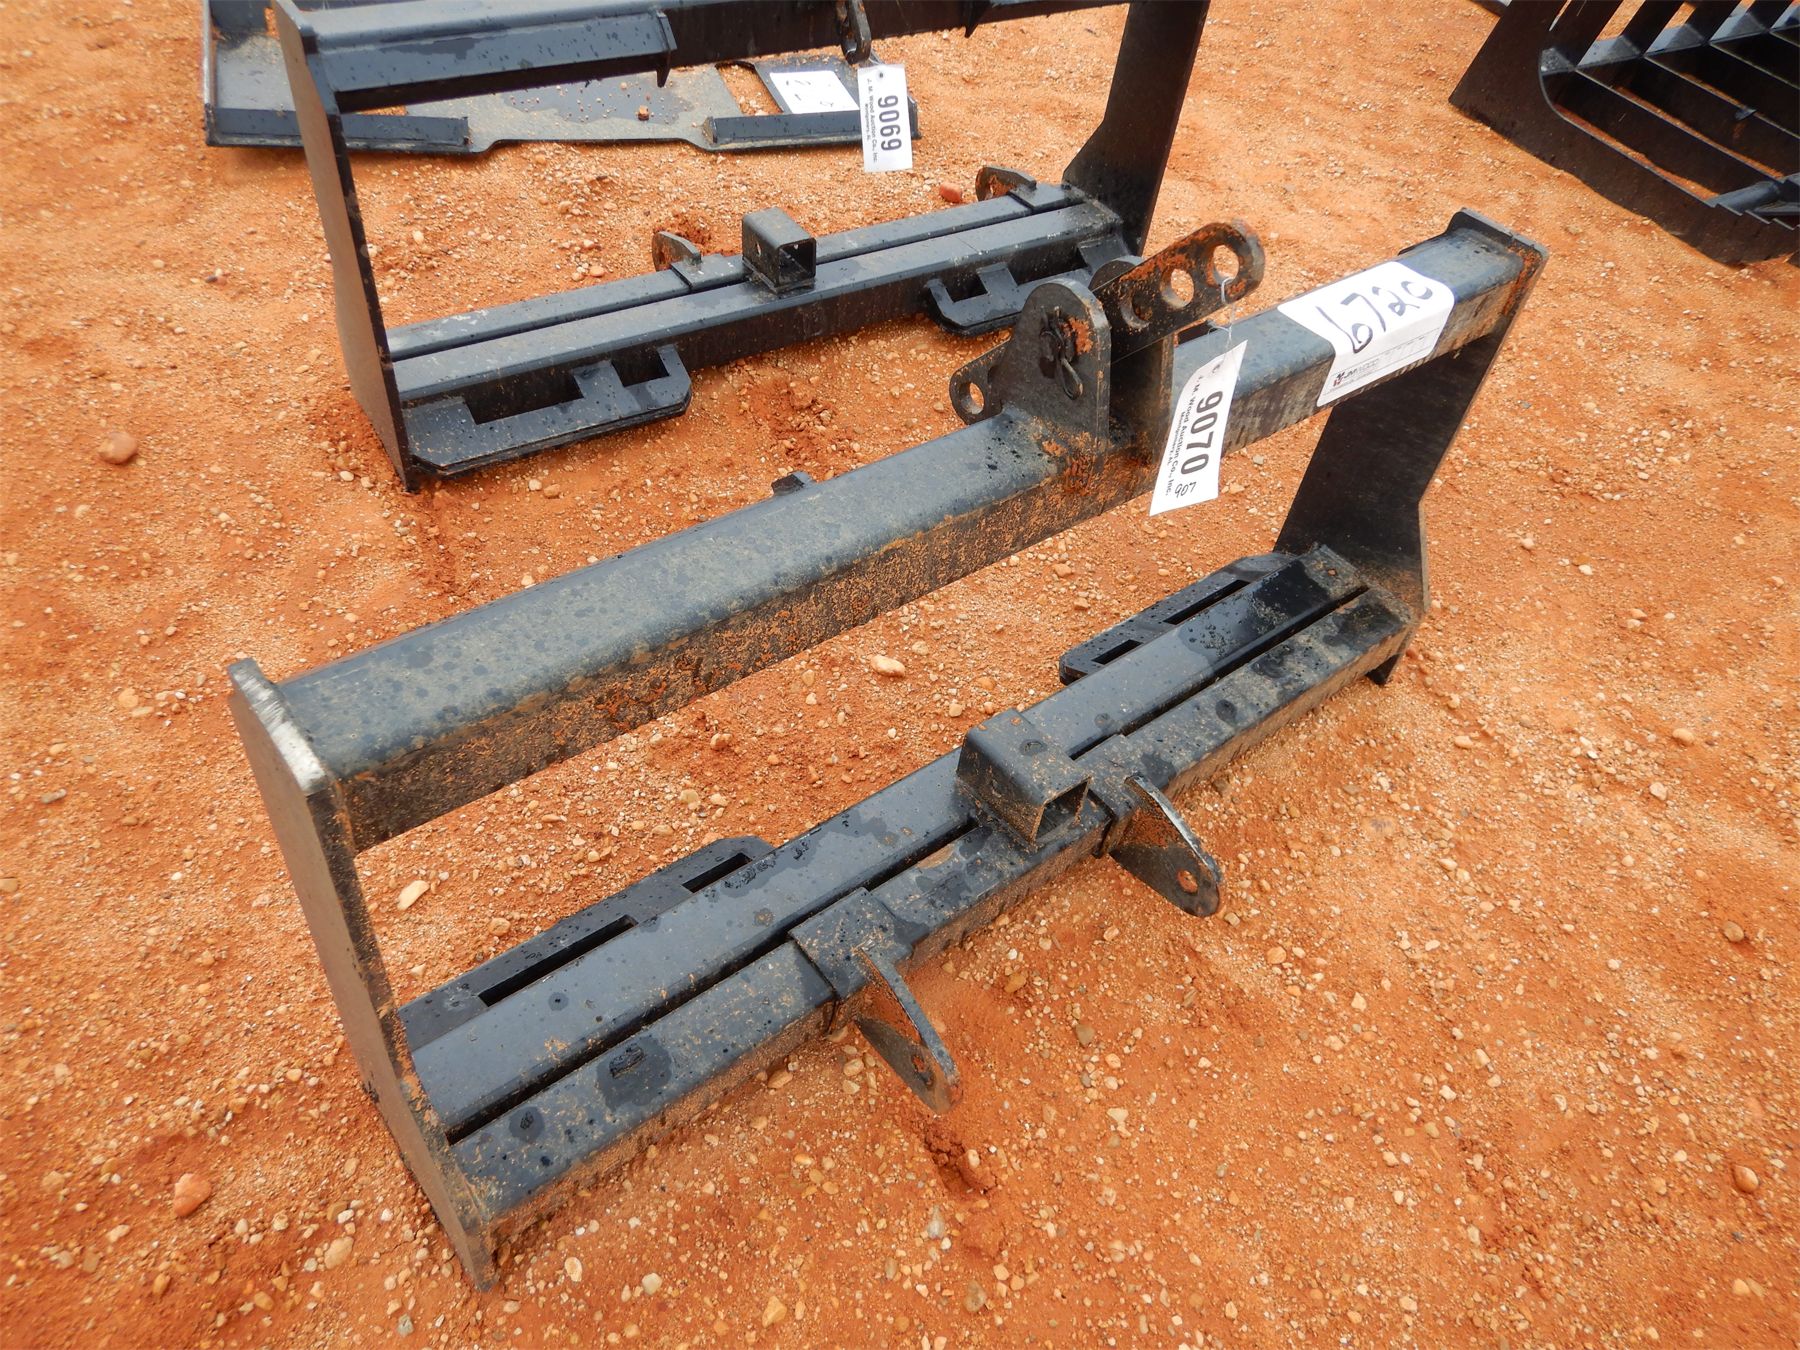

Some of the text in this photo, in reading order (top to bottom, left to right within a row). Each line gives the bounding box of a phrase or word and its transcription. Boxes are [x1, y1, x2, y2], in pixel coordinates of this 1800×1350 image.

[877, 95, 903, 151] 9069
[1183, 397, 1196, 423] Wood
[1174, 425, 1188, 458] Auction
[1180, 390, 1224, 475] 9070
[1165, 479, 1175, 496] Inc.
[1174, 481, 1197, 499] 907
